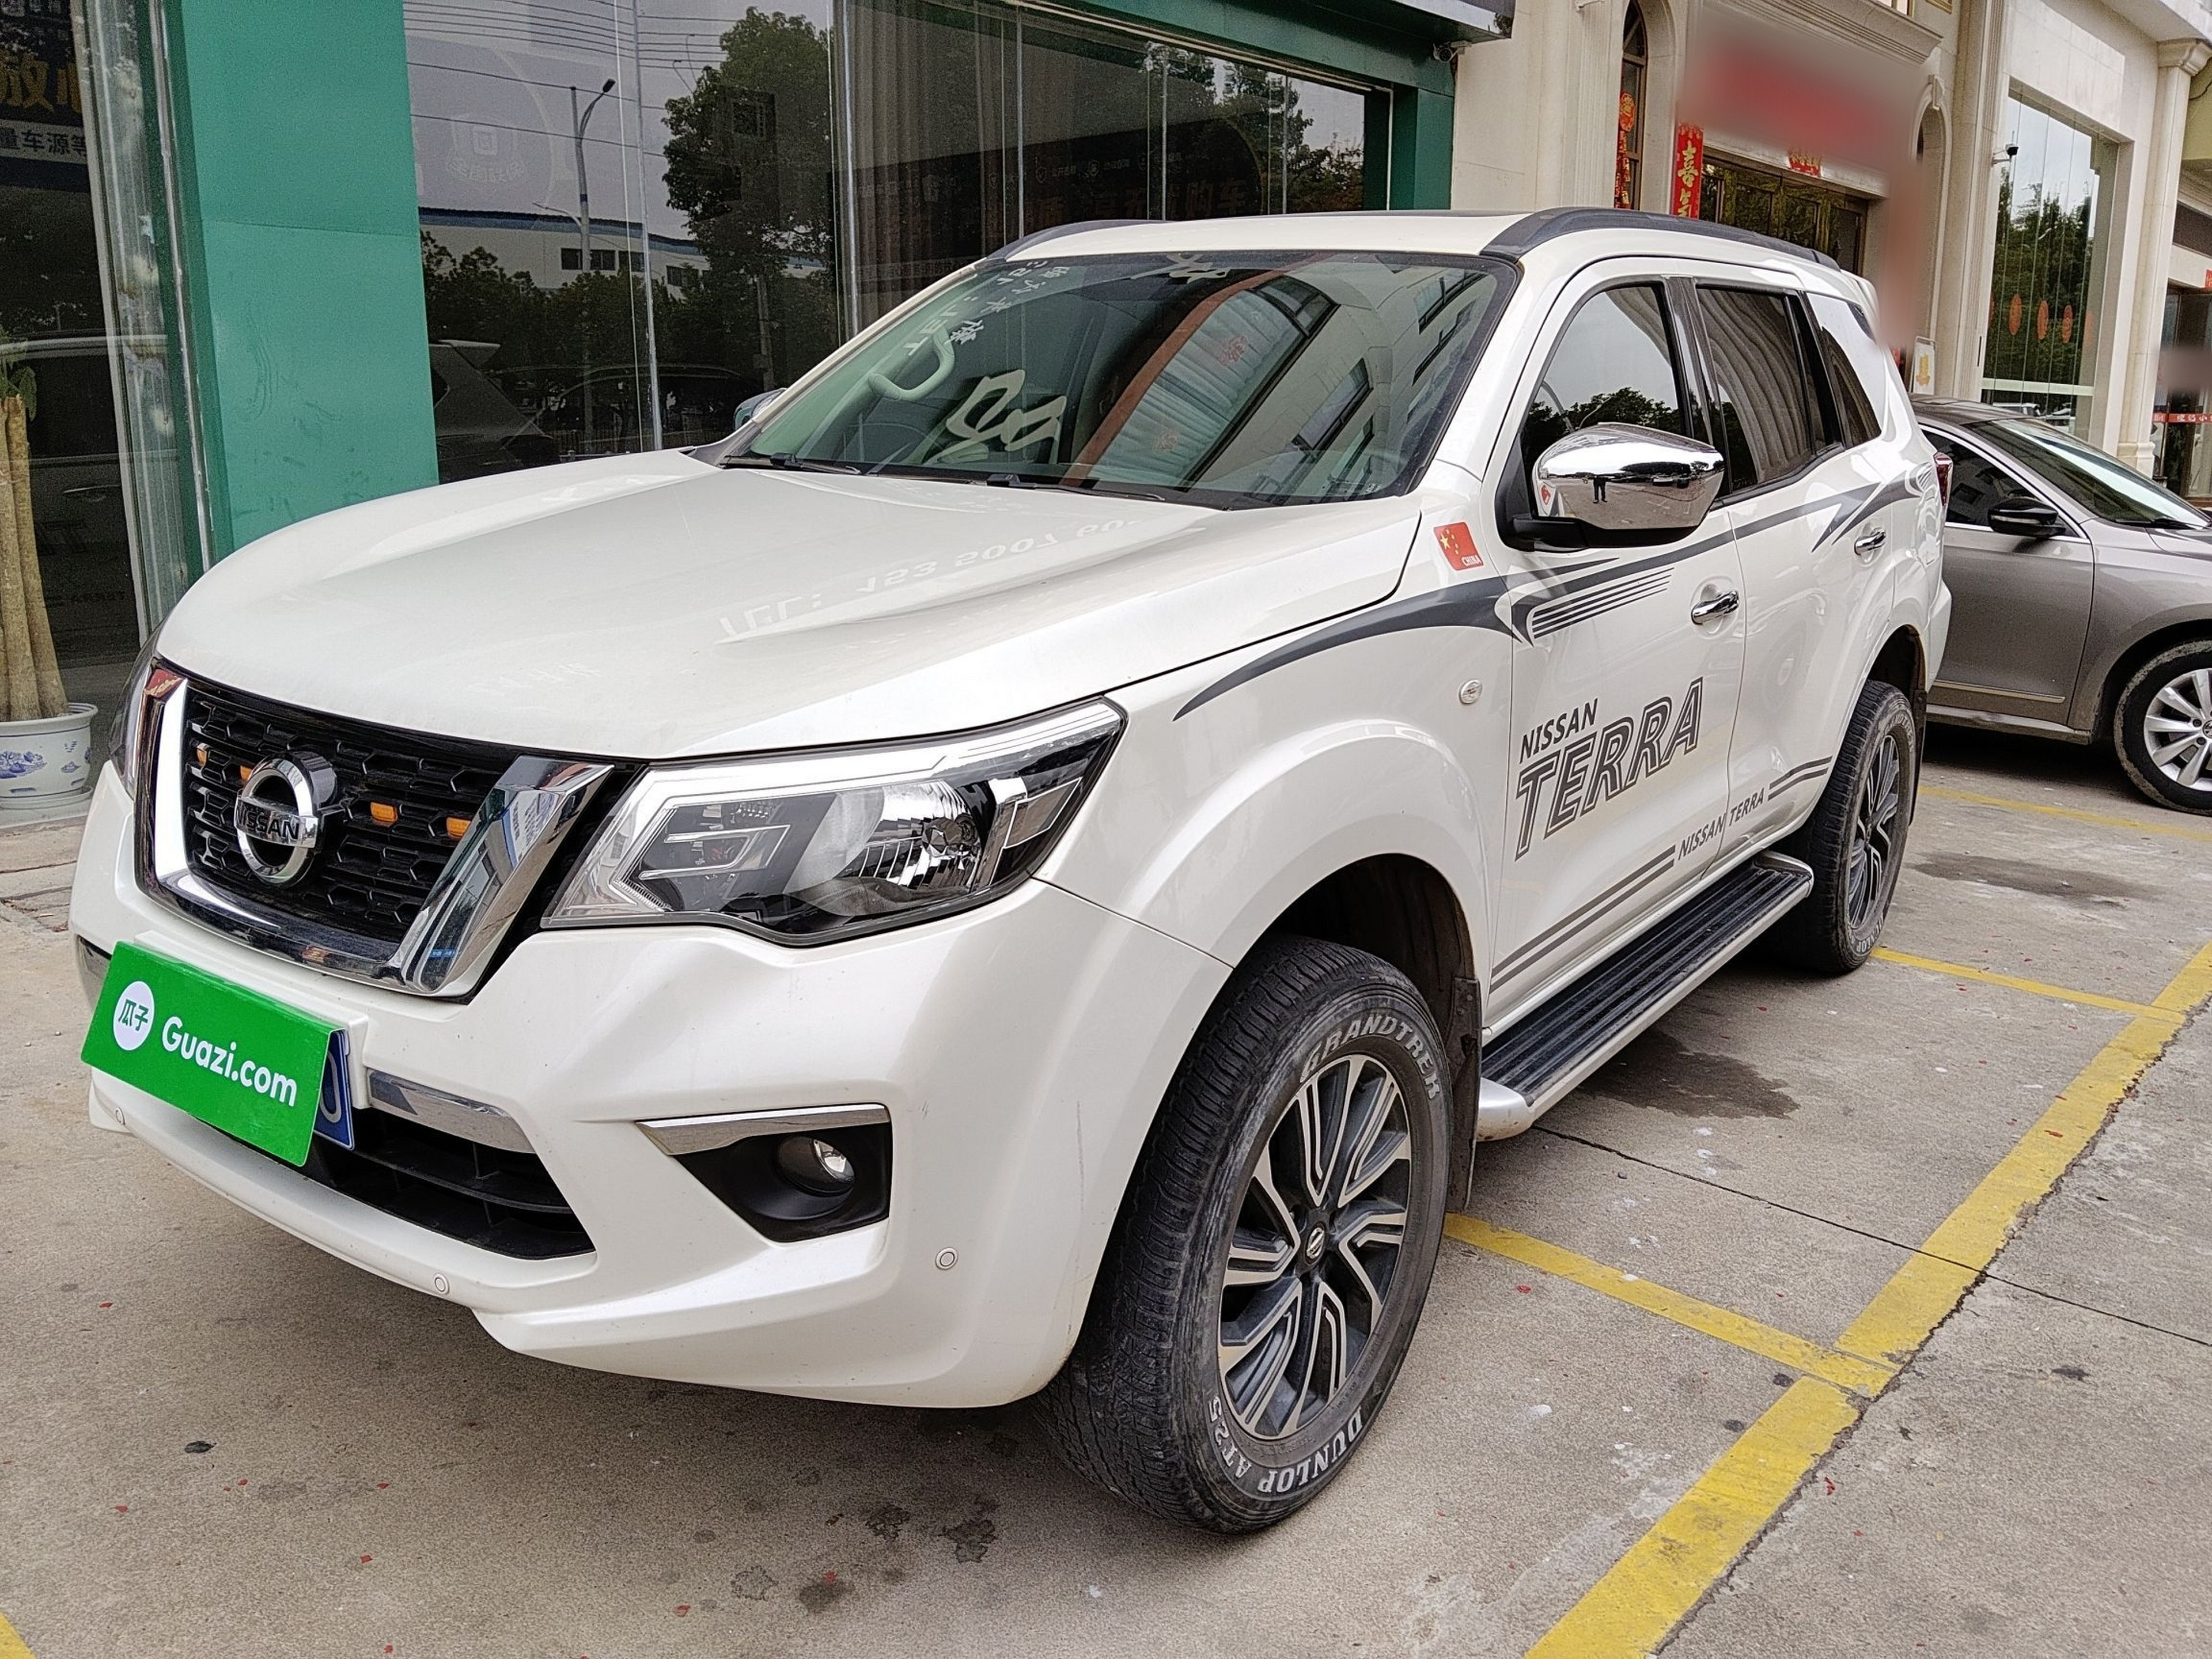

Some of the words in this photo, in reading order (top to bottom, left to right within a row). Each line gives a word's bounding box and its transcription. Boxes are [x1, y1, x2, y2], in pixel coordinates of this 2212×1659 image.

[1461, 554, 1482, 567] CHINA
[1519, 698, 1599, 764] NISSAN
[1514, 676, 1703, 862] TERRA
[236, 802, 300, 840] NISSAN
[1677, 812, 1728, 861] NISSAN
[1729, 787, 1764, 827] TERRA
[118, 998, 150, 1032] 瓜子
[161, 1016, 298, 1107] Guazi.com
[1299, 1013, 1440, 1100] GRANDTREK
[1257, 1406, 1363, 1493] DUNLOP
